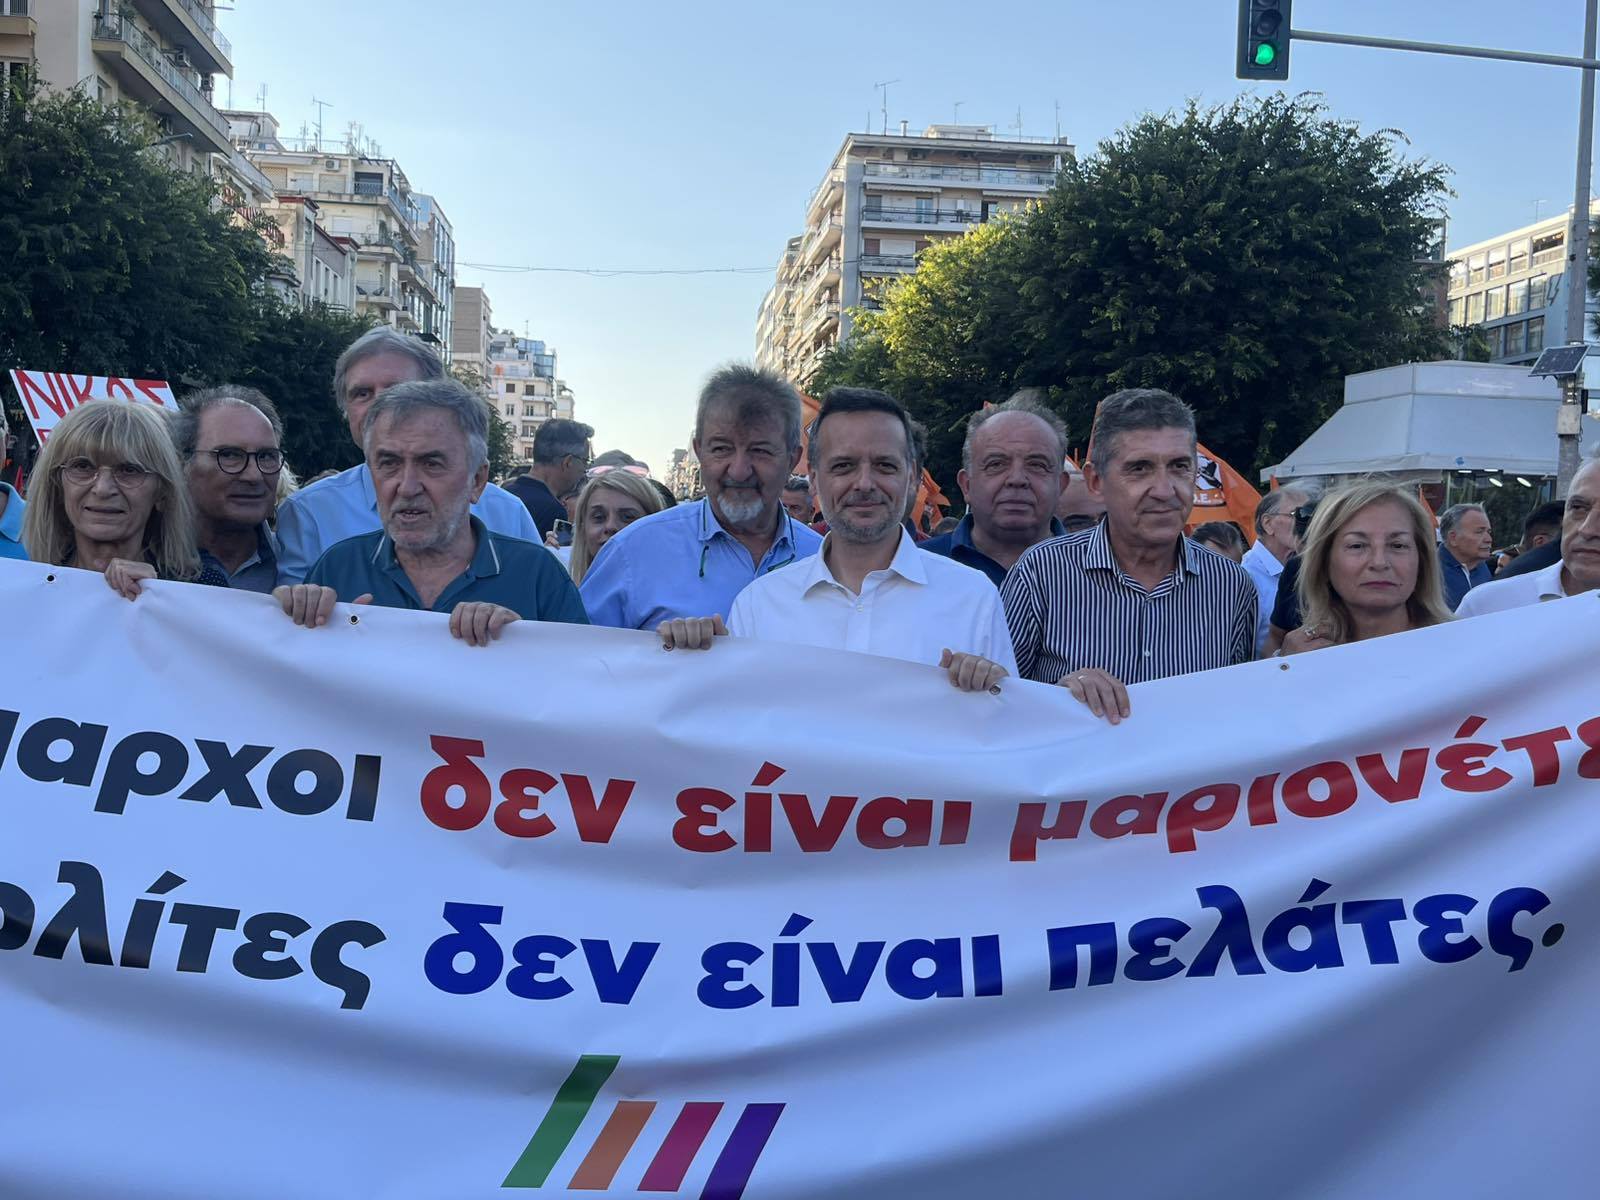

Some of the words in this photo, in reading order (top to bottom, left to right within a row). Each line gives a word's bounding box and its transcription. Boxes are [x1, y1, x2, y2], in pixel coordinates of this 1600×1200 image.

[0, 709, 382, 822] αρχοι
[420, 734, 637, 844] δεν
[672, 760, 973, 853] είναι
[423, 901, 661, 1005] δεν
[696, 912, 1003, 1010] είναι
[1046, 877, 1569, 992] πελάτες.
